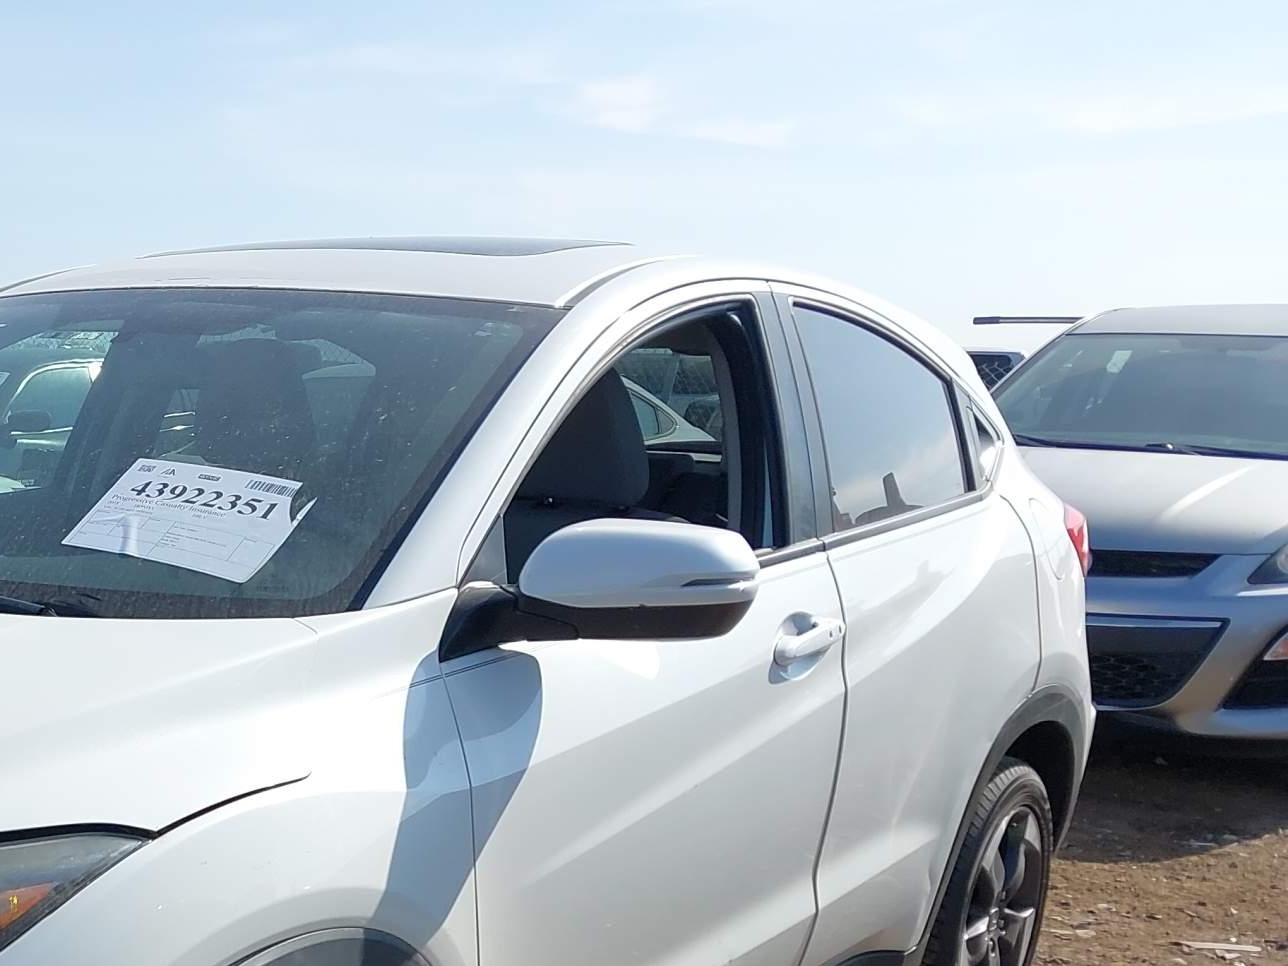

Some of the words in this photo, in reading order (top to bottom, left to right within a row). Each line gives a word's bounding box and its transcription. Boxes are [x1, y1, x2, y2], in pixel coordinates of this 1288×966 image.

[111, 494, 154, 505] Progressive
[155, 500, 190, 511] Casualty
[189, 506, 227, 518] Insurance
[131, 480, 279, 521] 43922351
